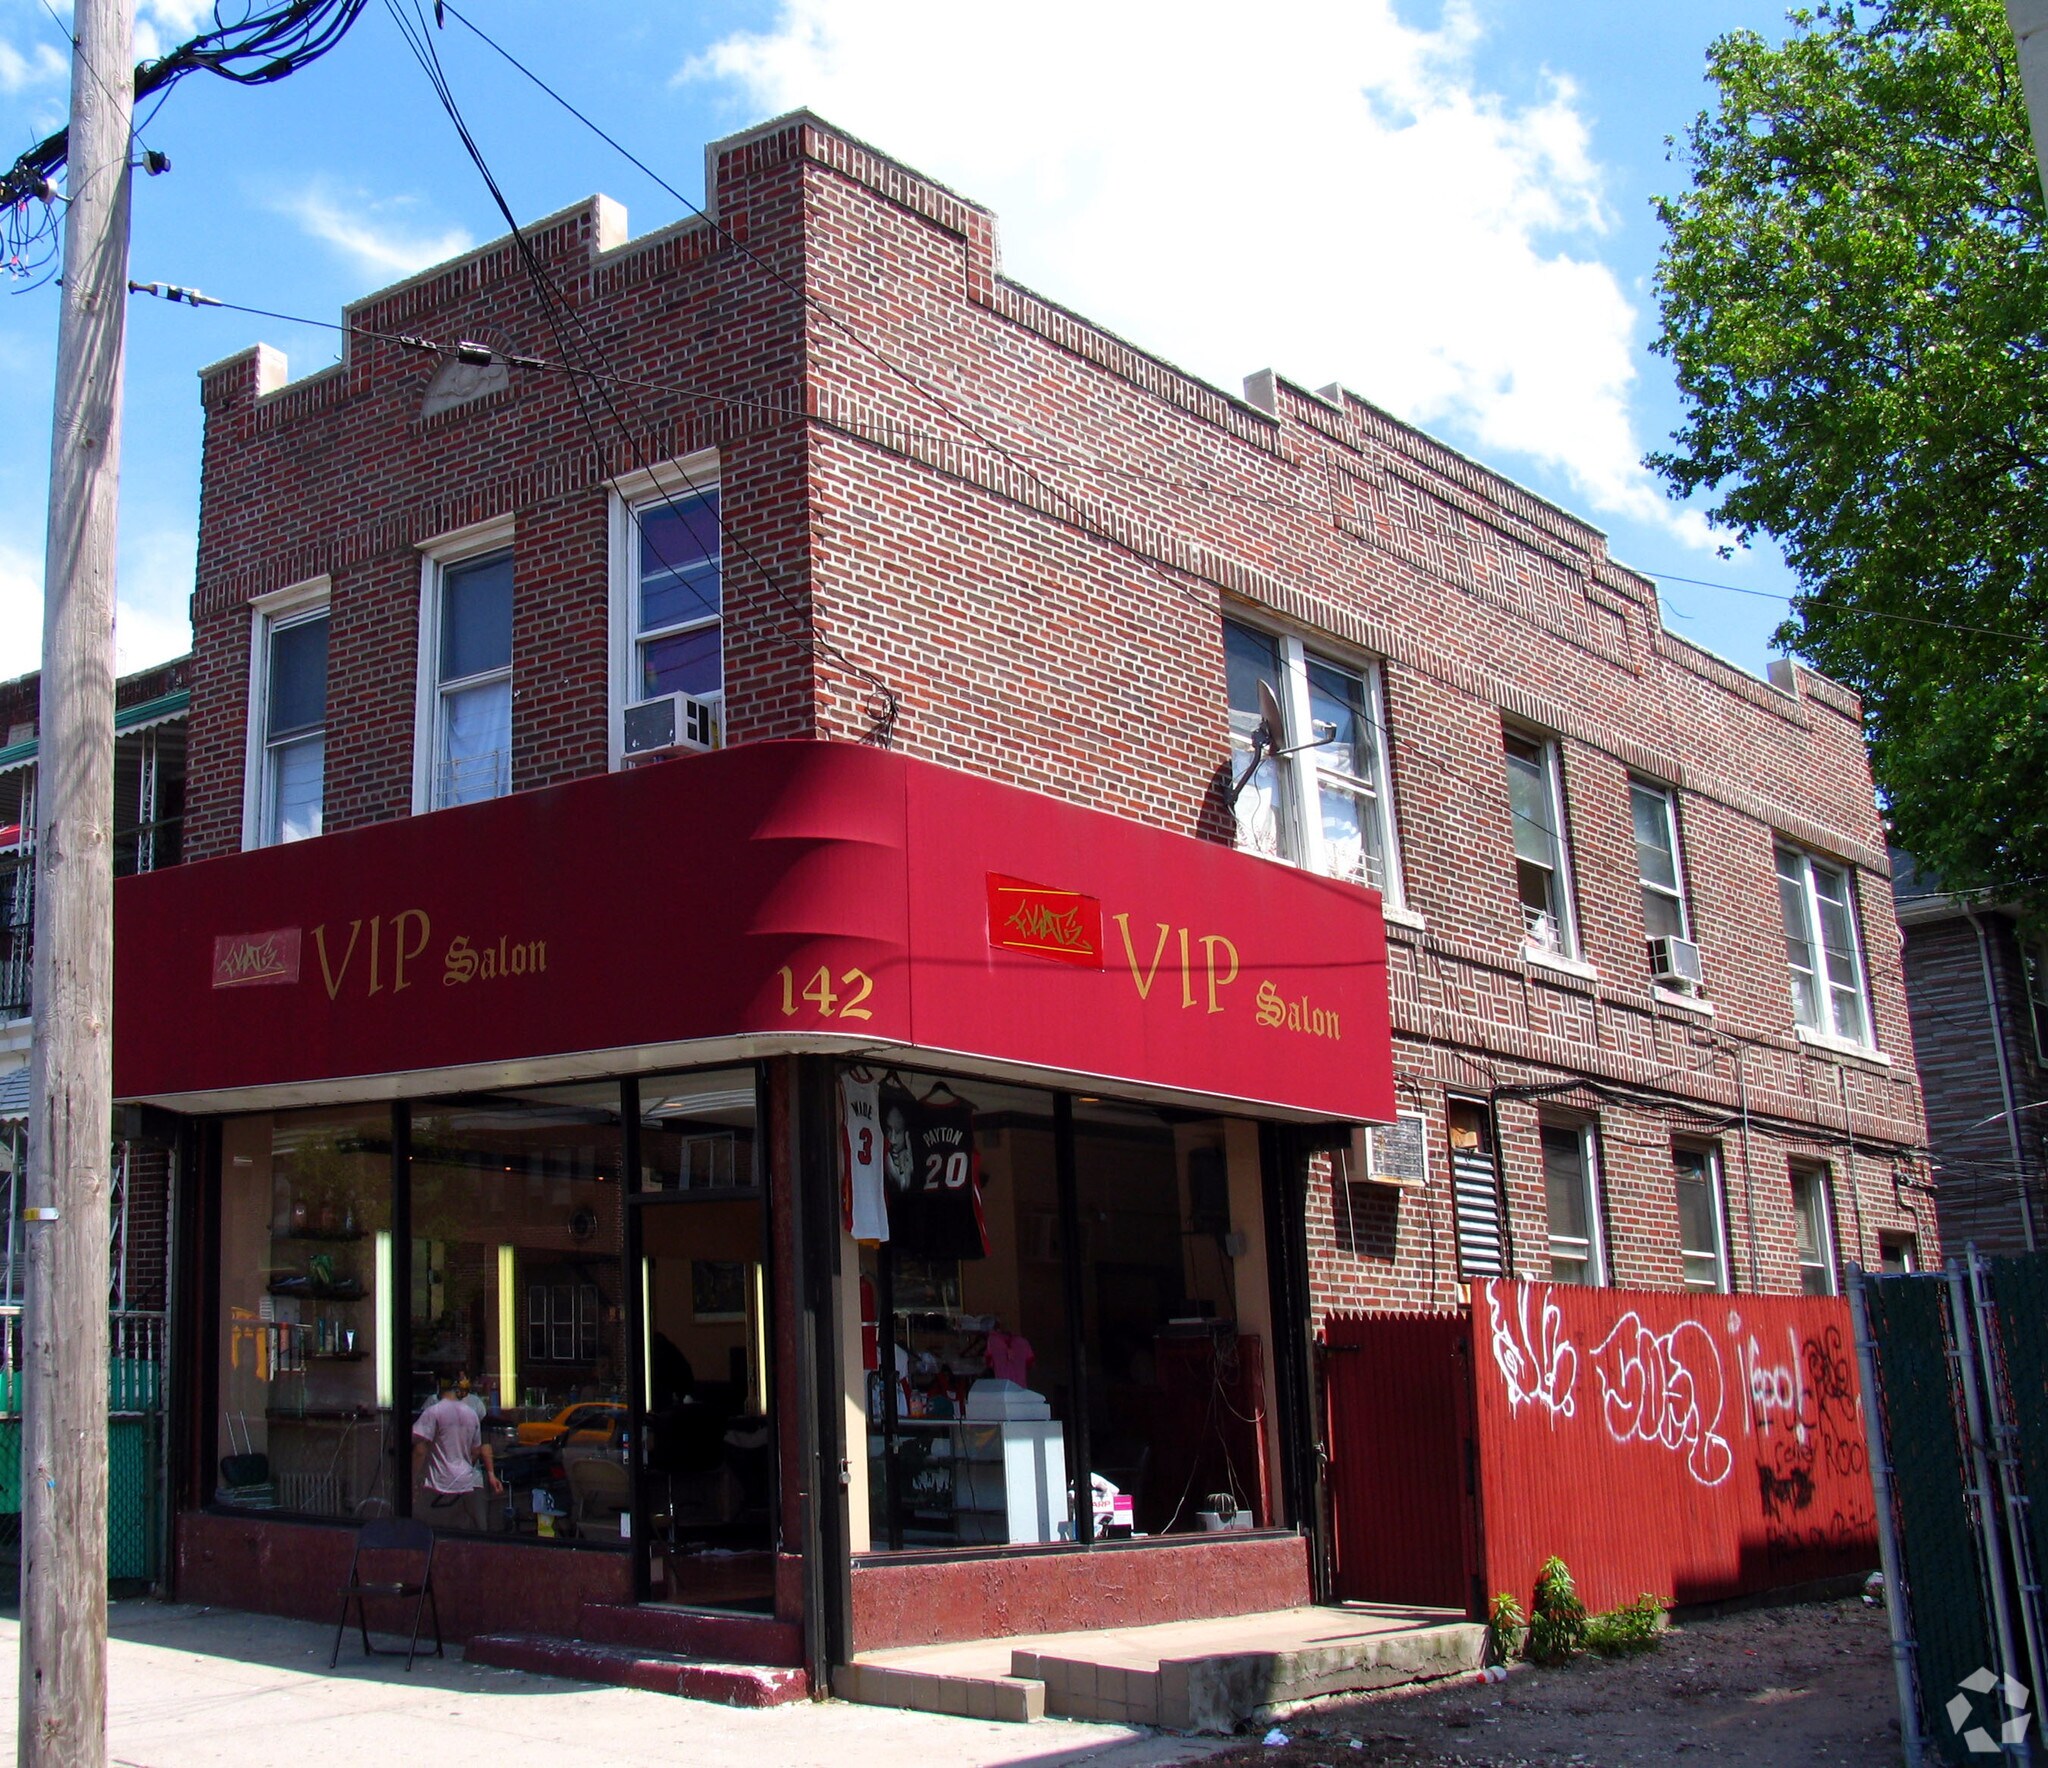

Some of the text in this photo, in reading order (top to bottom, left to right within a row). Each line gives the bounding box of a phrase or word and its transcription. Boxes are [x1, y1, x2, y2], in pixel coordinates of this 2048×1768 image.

[311, 908, 431, 1001] VIP
[443, 935, 548, 986] Salon
[1112, 912, 1240, 1014] VIP
[1255, 979, 1341, 1041] Salon
[777, 965, 873, 1021] 142
[857, 1127, 873, 1166] 3
[922, 1127, 964, 1149] PAYTON
[923, 1152, 968, 1190] 20
